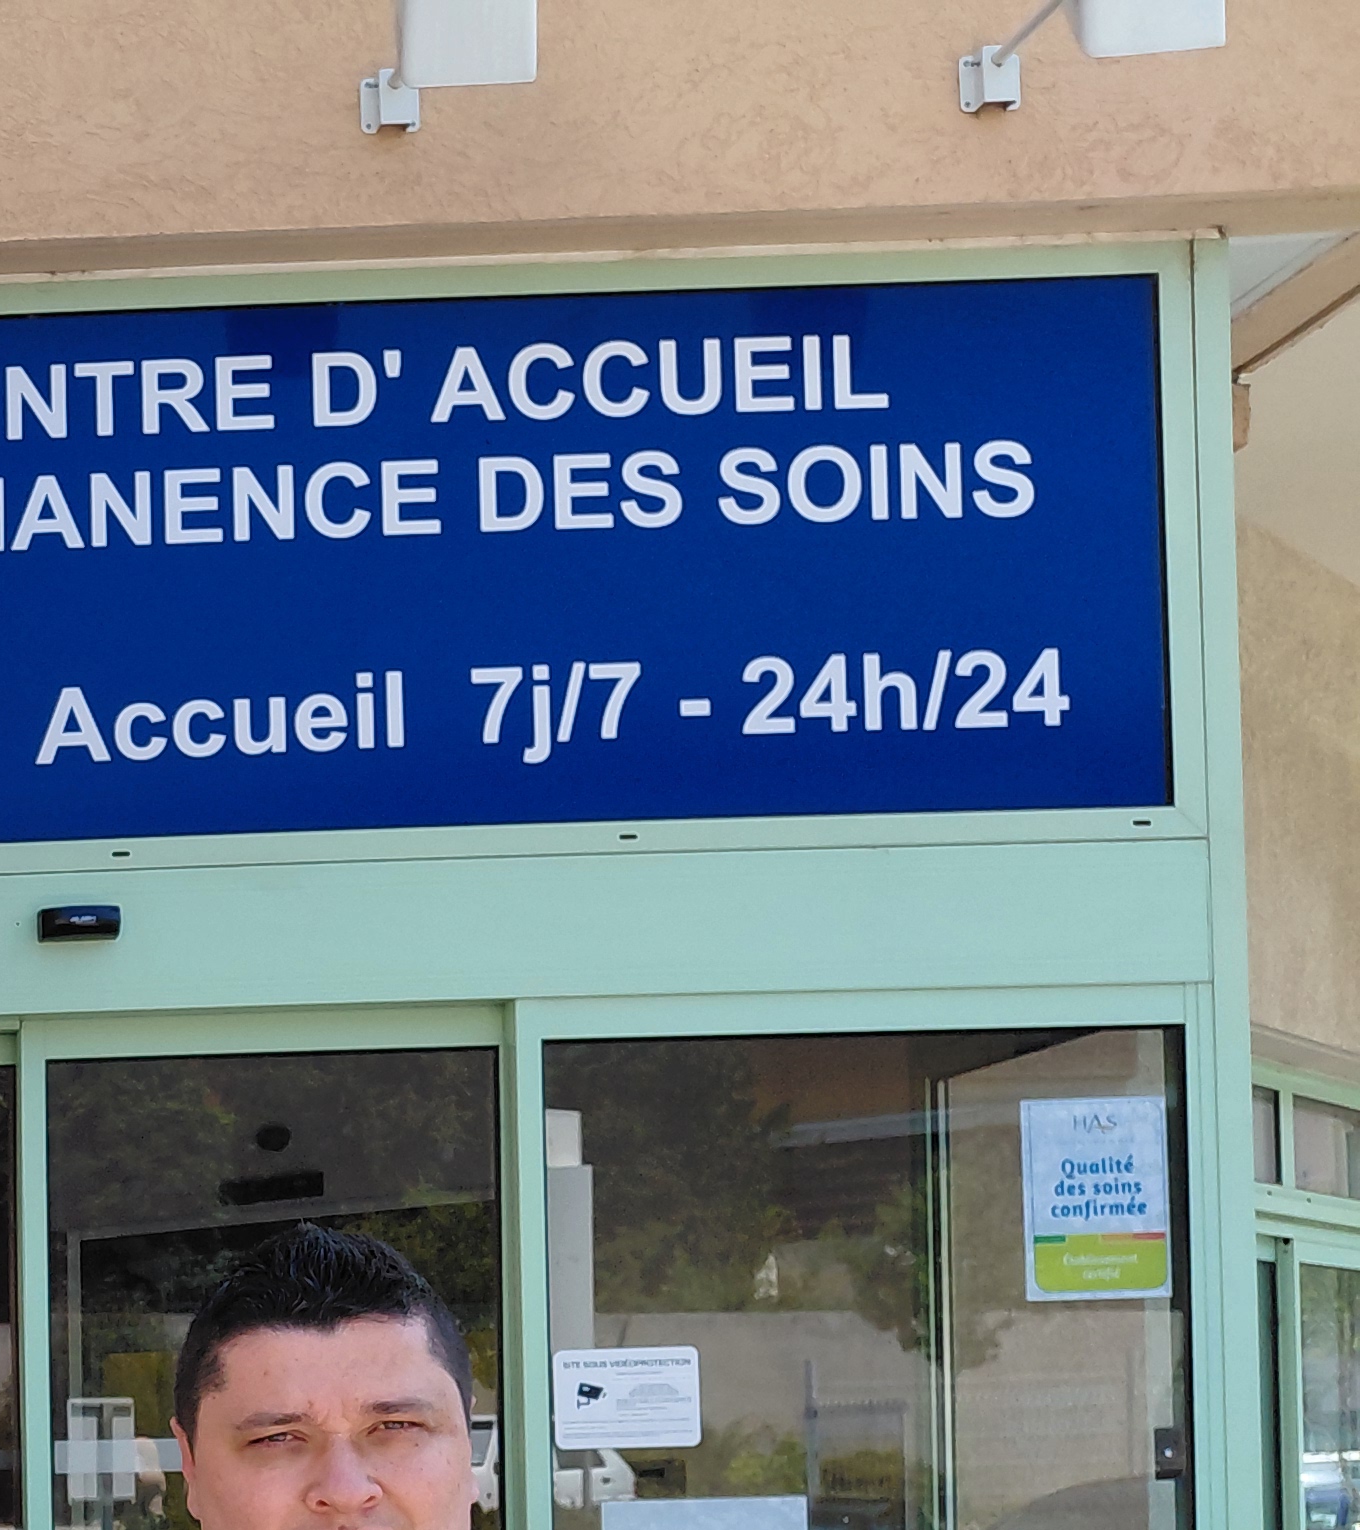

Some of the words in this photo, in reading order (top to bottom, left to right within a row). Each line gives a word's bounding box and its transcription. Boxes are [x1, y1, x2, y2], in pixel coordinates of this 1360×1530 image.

[313, 350, 401, 426] D'
[431, 335, 888, 422] ACCUEIL
[479, 451, 682, 532] DES
[719, 441, 1034, 527] SOINS
[36, 671, 404, 764] Accueil
[471, 662, 640, 763] 7j/7
[743, 649, 1069, 734] 24h/24
[1073, 1114, 1117, 1134] HAS
[1061, 1153, 1135, 1180] Qualité
[1054, 1178, 1086, 1197] des
[1093, 1177, 1142, 1196] soins
[1050, 1195, 1148, 1221] confirmée
